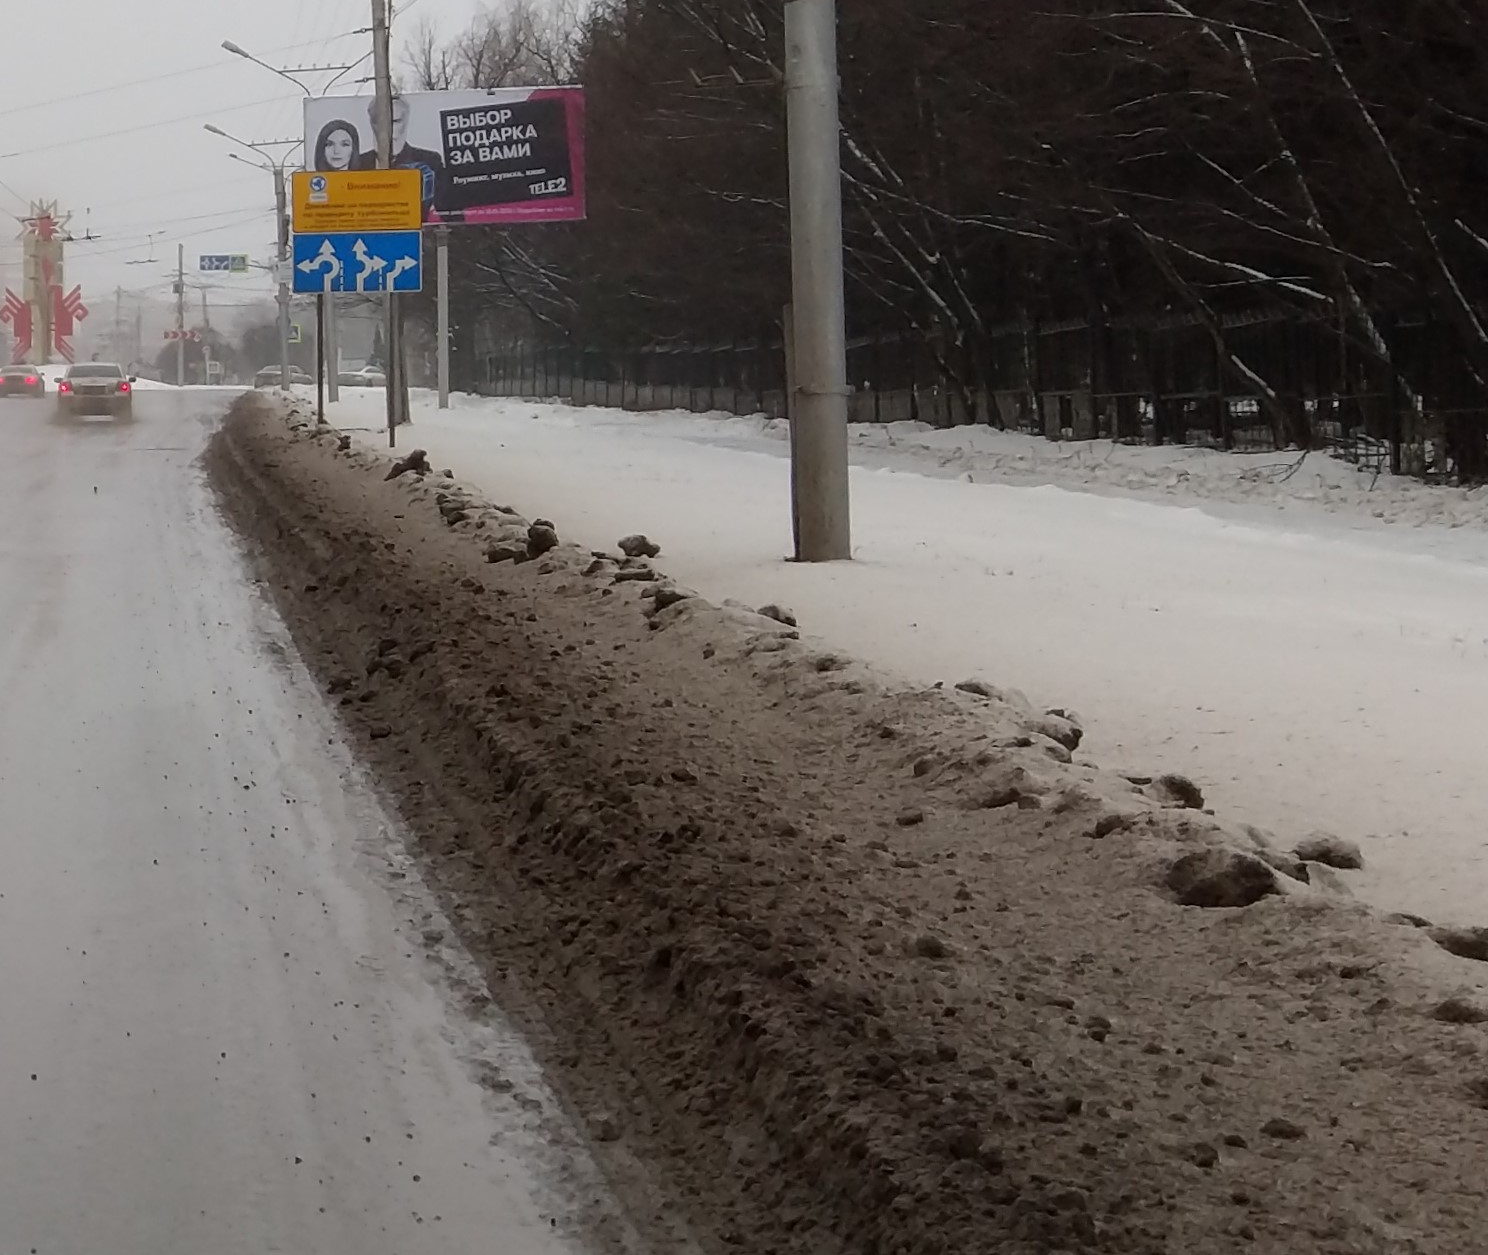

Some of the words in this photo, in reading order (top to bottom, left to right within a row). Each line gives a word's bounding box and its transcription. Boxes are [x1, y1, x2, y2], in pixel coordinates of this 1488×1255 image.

[446, 109, 512, 130] ВЫБОР
[448, 124, 538, 147] ПОДАРКА
[449, 149, 475, 165] ЗА
[479, 143, 531, 162] ВАМИ
[528, 177, 567, 195] TELE2
